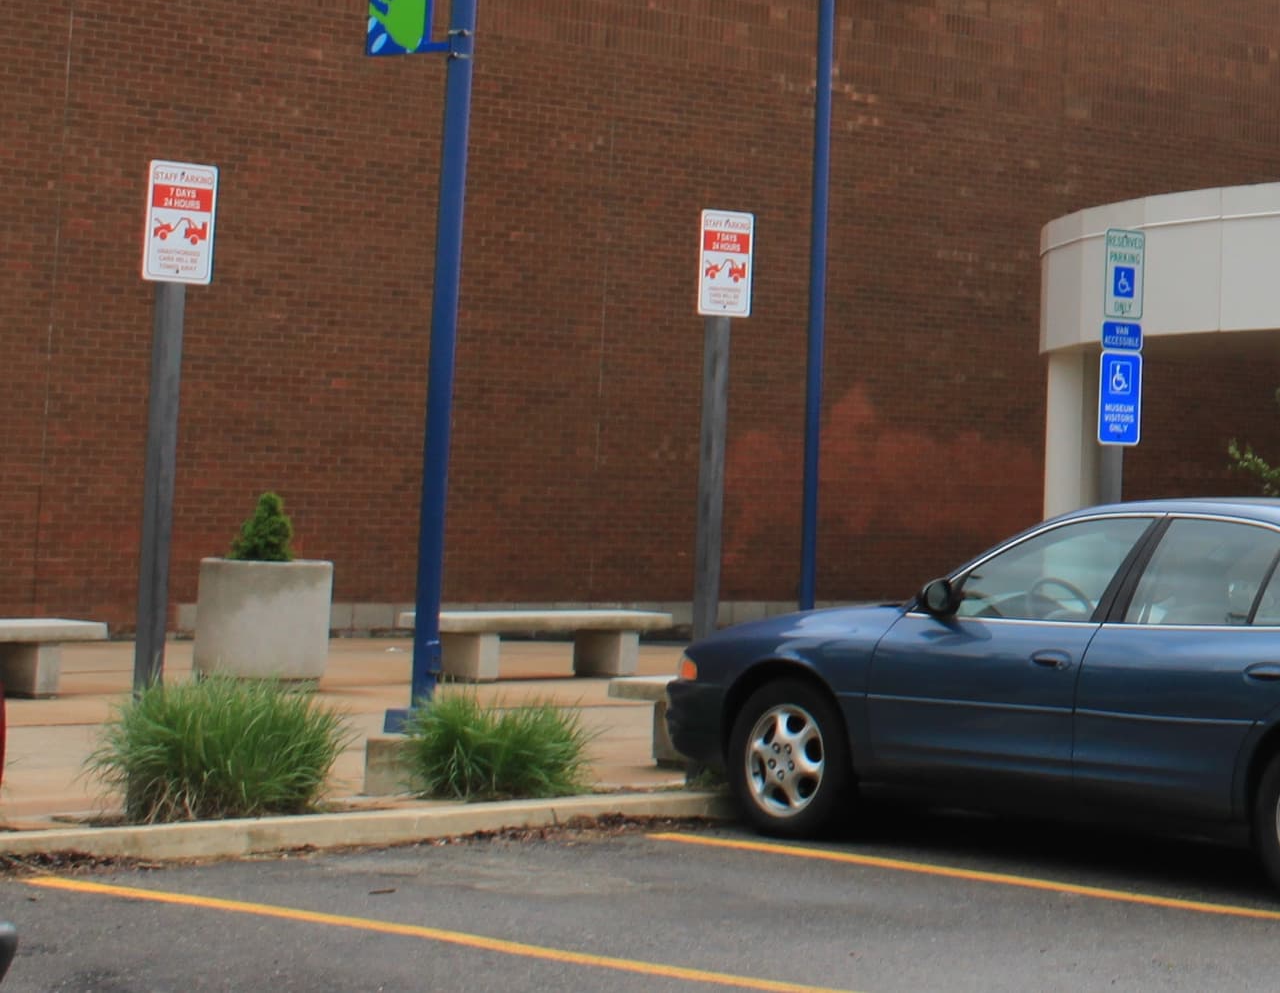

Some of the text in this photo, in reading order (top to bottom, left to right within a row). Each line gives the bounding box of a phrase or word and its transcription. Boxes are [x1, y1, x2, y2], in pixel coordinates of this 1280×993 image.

[155, 171, 213, 185] STAFF PARKING
[169, 187, 197, 199] 7 DAYS
[163, 197, 201, 210] 24 HOURS
[721, 233, 737, 242] DAYS
[1107, 235, 1143, 250] RESERVED
[720, 242, 741, 252] HOURS
[1109, 252, 1140, 265] PARKING
[1113, 300, 1133, 312] ONLY
[1115, 326, 1129, 336] VAN
[1104, 335, 1139, 347] ACCESSIBLE
[1104, 403, 1134, 413] MUSEUM
[1104, 413, 1134, 423] VISITORS
[1109, 423, 1129, 433] ONLY
